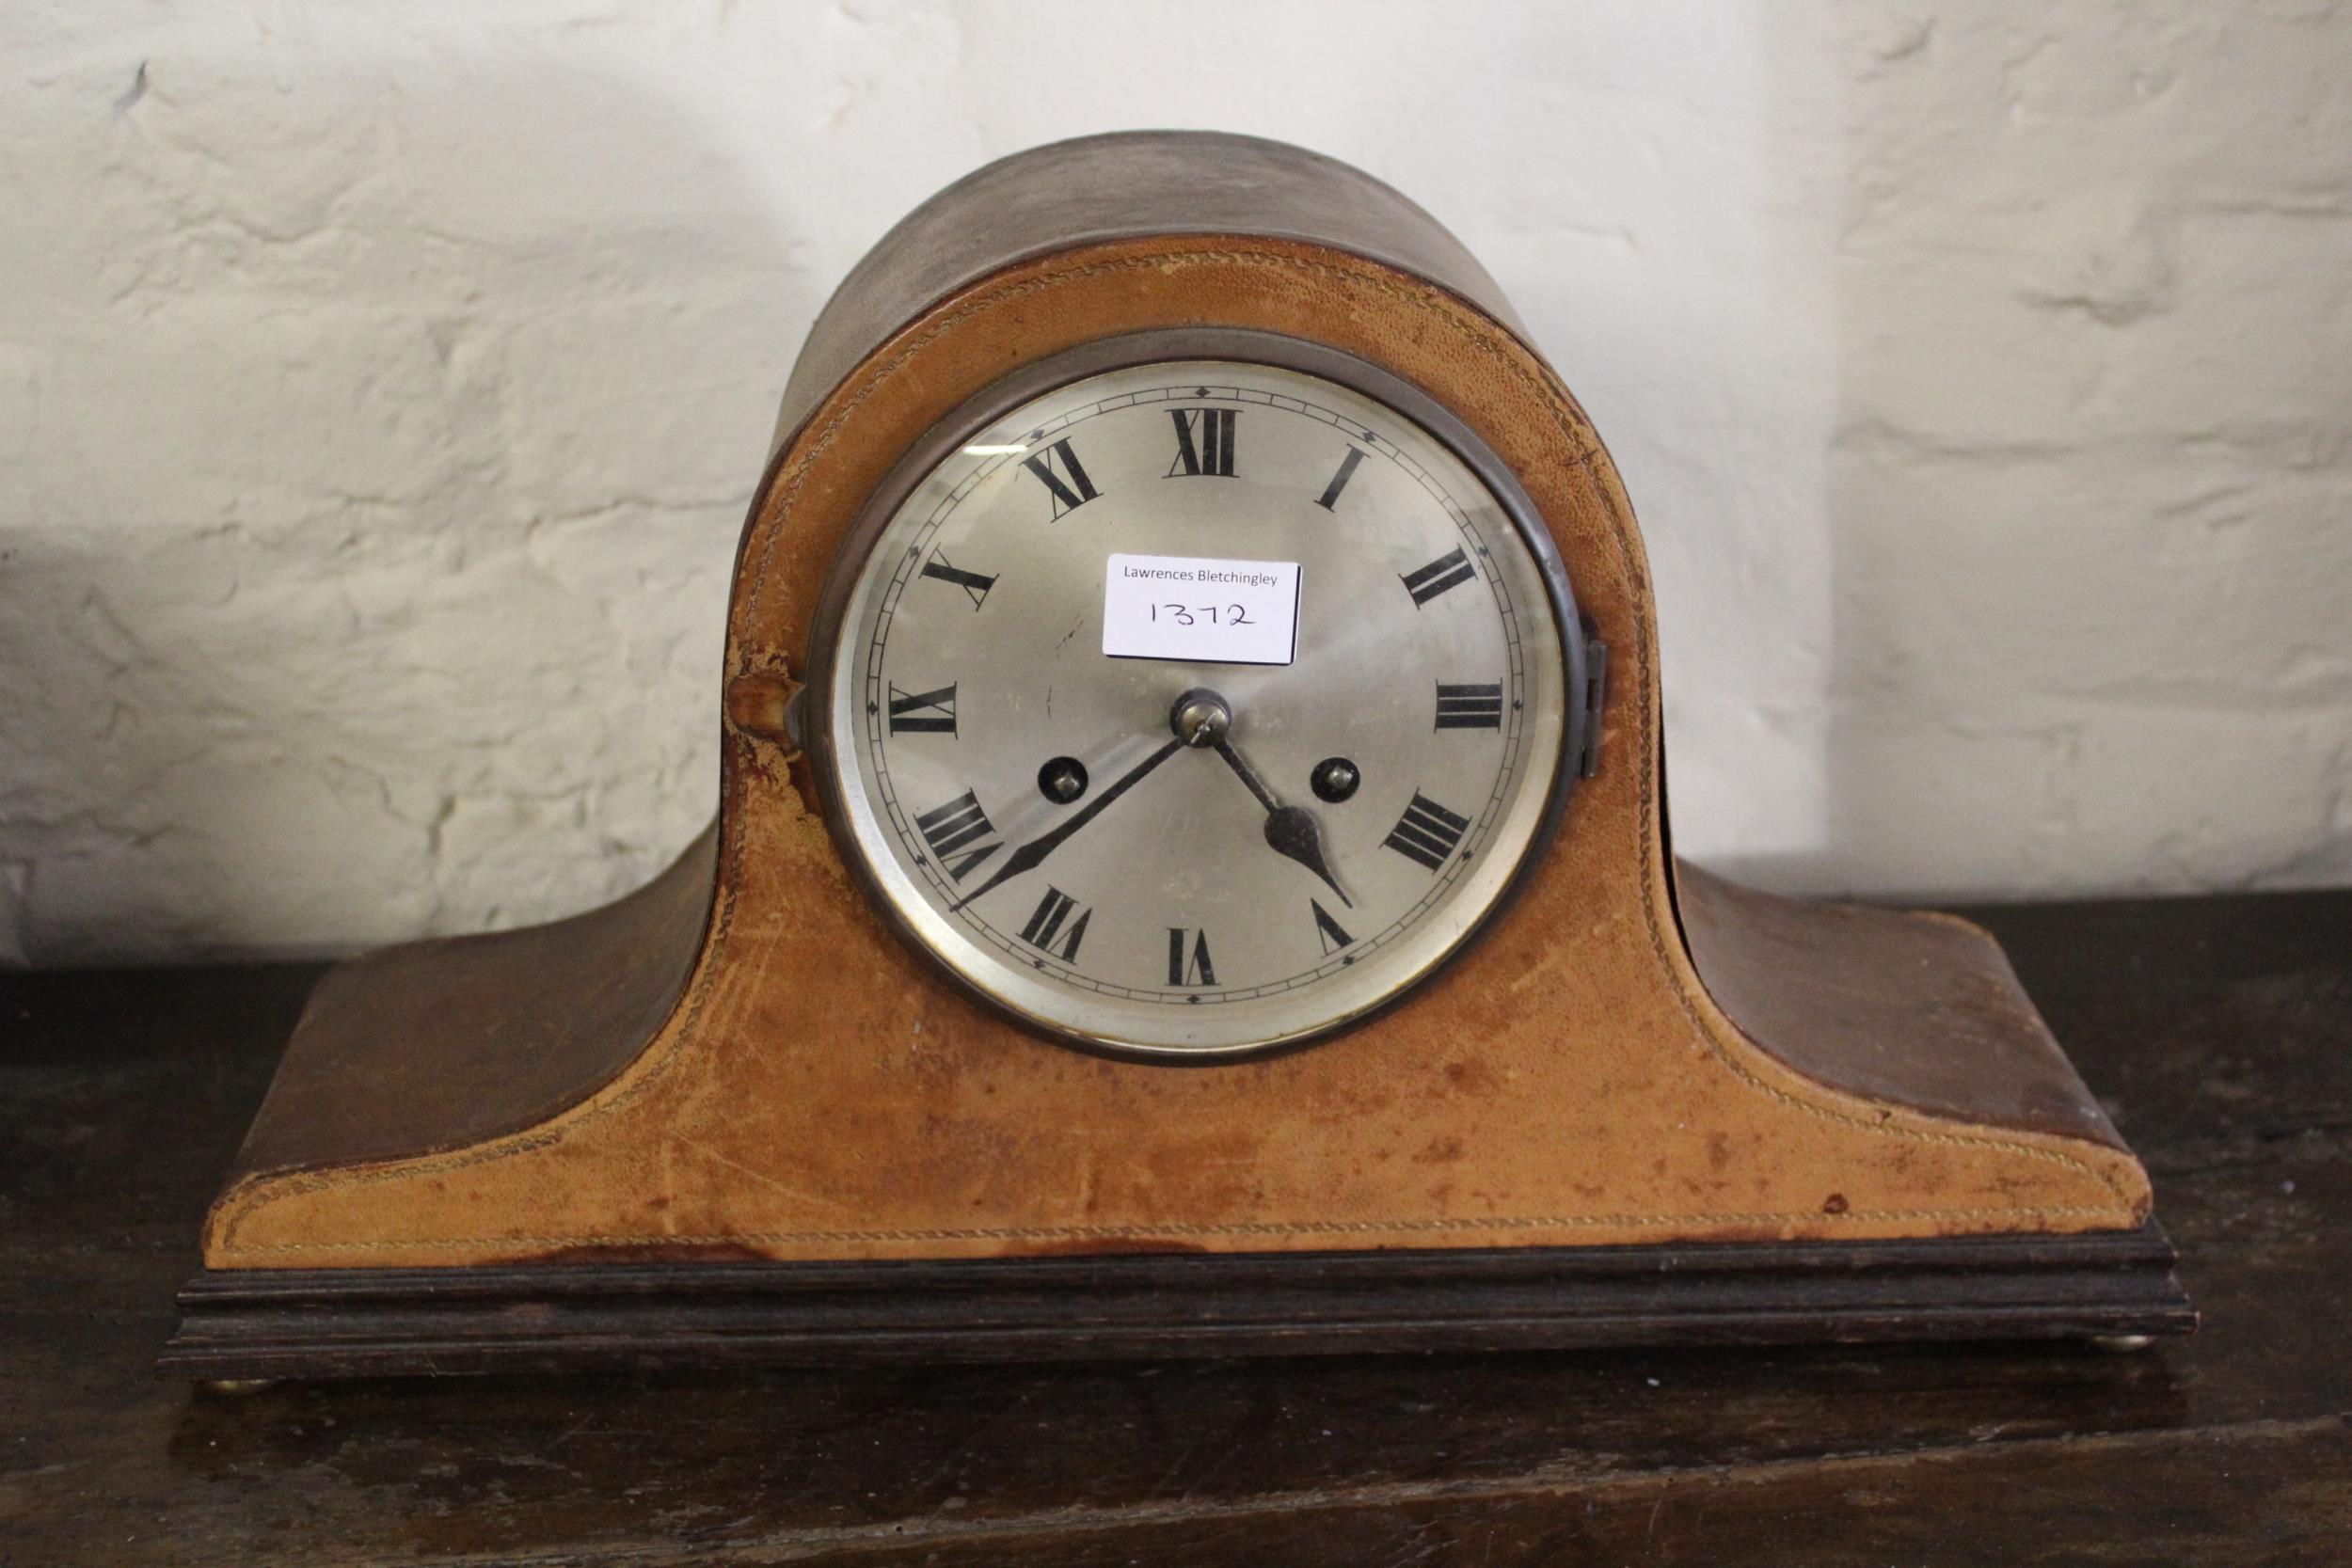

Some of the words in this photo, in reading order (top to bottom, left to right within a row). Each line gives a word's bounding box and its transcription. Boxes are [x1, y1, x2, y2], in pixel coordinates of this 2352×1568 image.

[1162, 408, 1243, 478] XII
[1019, 436, 1104, 523] XI
[1314, 443, 1371, 512] I
[922, 544, 999, 611] X
[1124, 565, 1194, 581] Lawrences
[1198, 570, 1278, 587] Bletchingley
[1399, 545, 1478, 610] II
[1152, 603, 1256, 626] 1372
[889, 681, 958, 738] IX
[1435, 678, 1502, 732] III
[913, 787, 1006, 885] VIII
[1379, 787, 1470, 875] IIII
[1016, 884, 1092, 964] VII
[1311, 897, 1357, 958] V
[1168, 928, 1220, 987] VI
